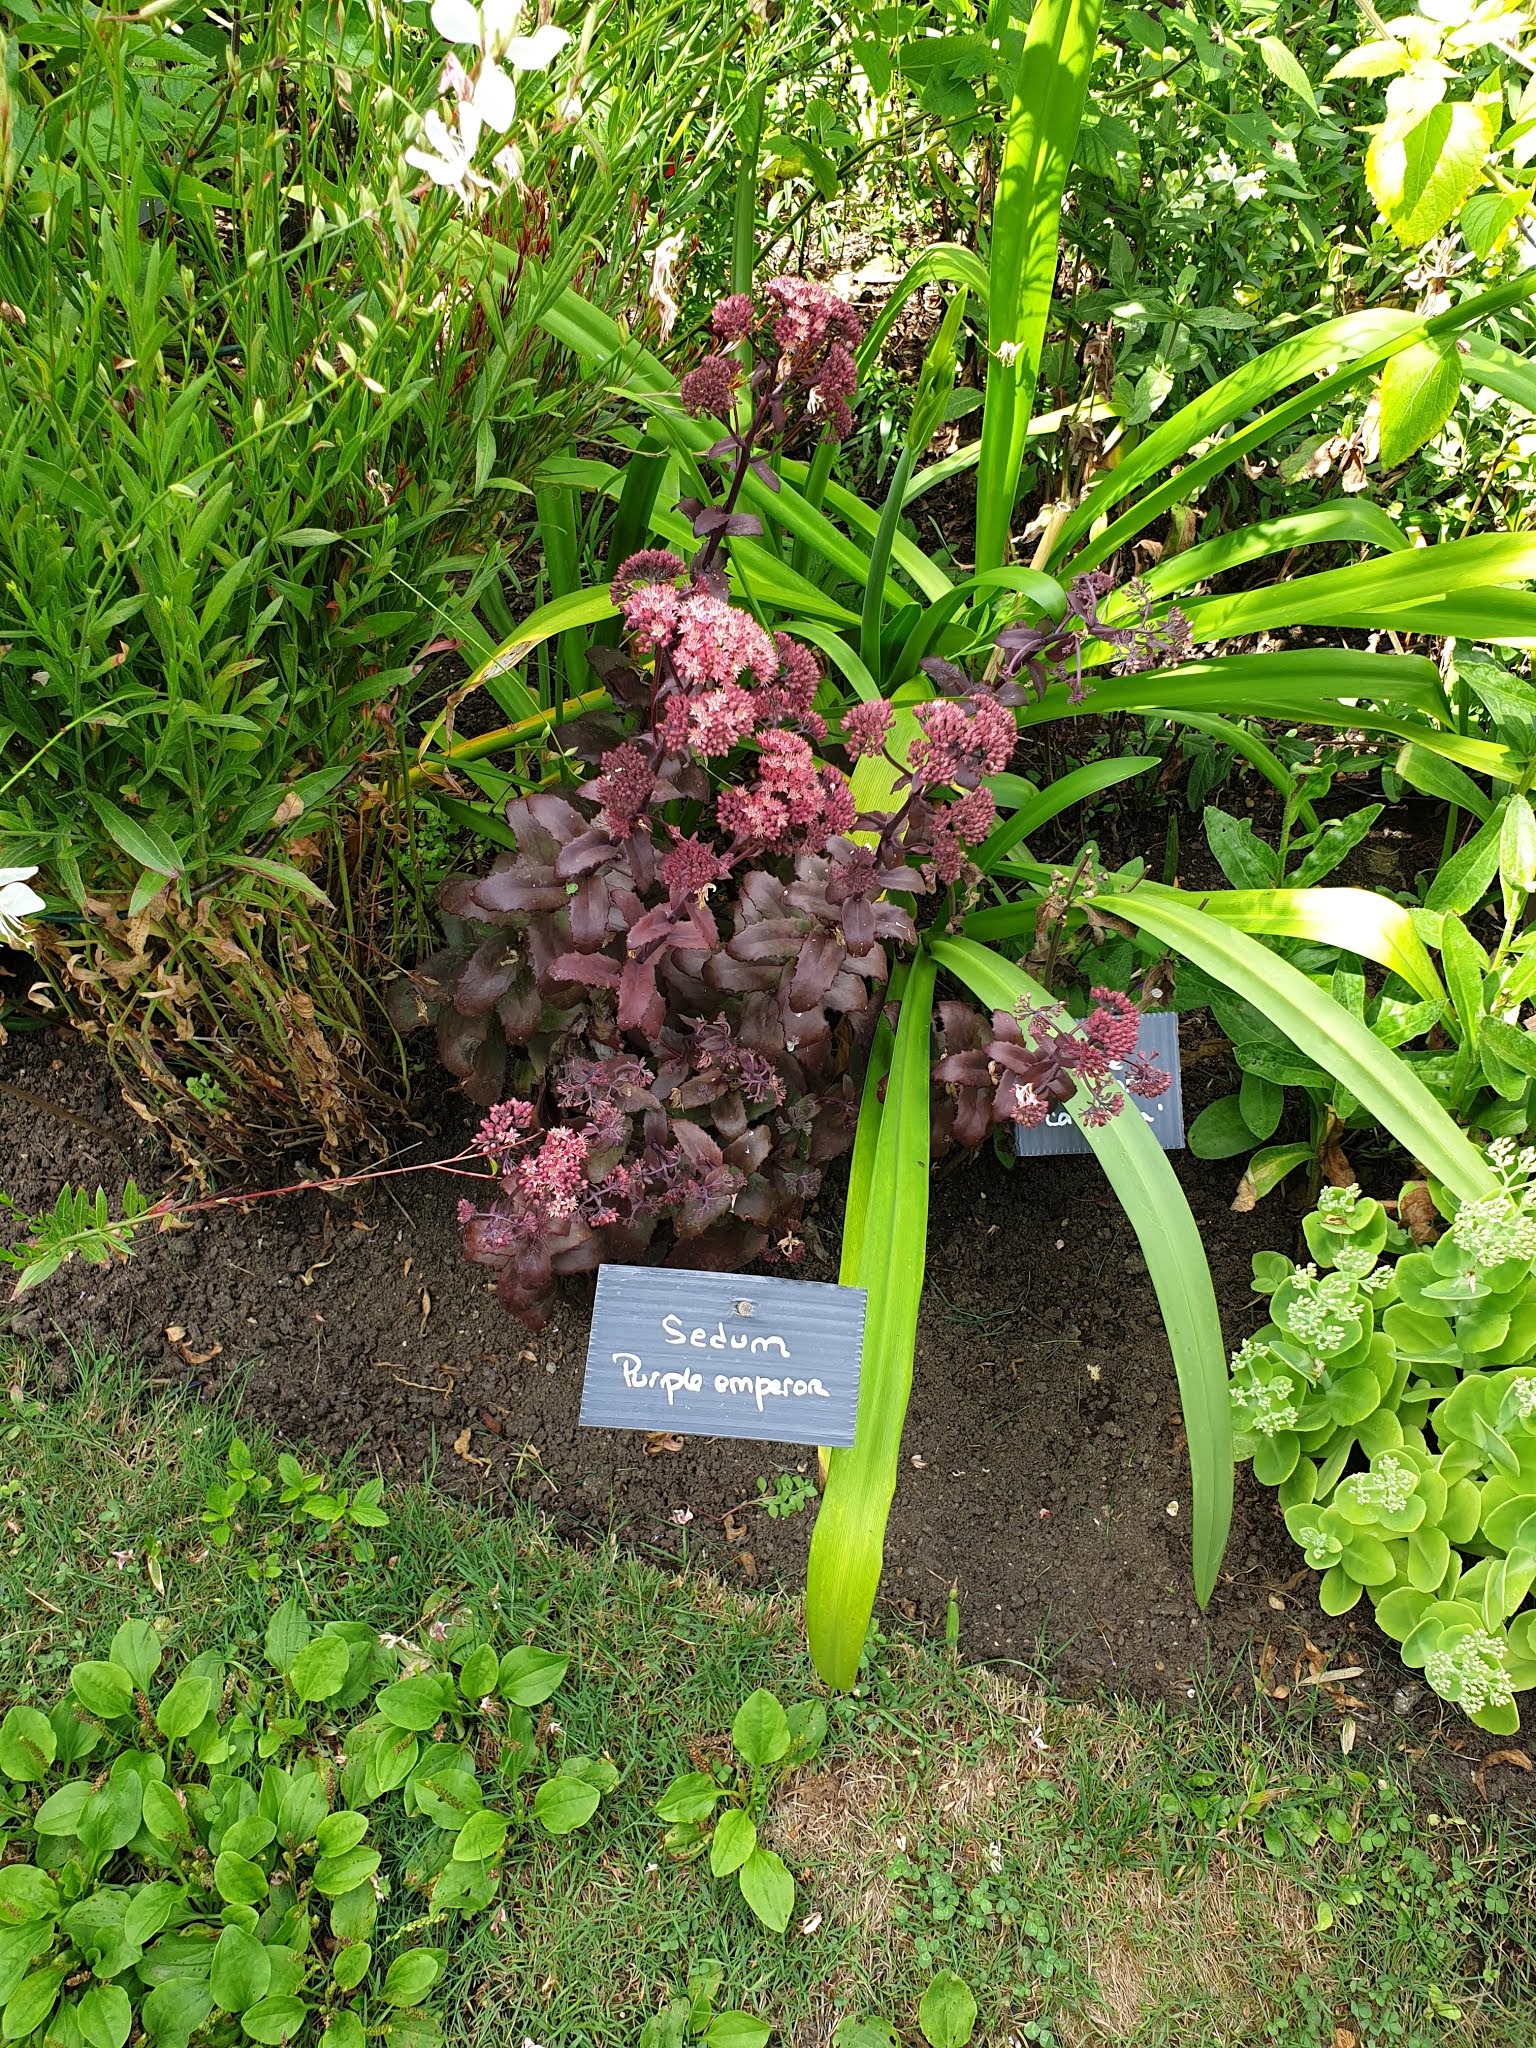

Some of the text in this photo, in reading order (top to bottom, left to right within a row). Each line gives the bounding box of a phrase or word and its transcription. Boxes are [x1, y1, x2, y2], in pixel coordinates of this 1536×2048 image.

[660, 1313, 791, 1358] Sedum
[611, 1352, 831, 1413] Purple emperor
